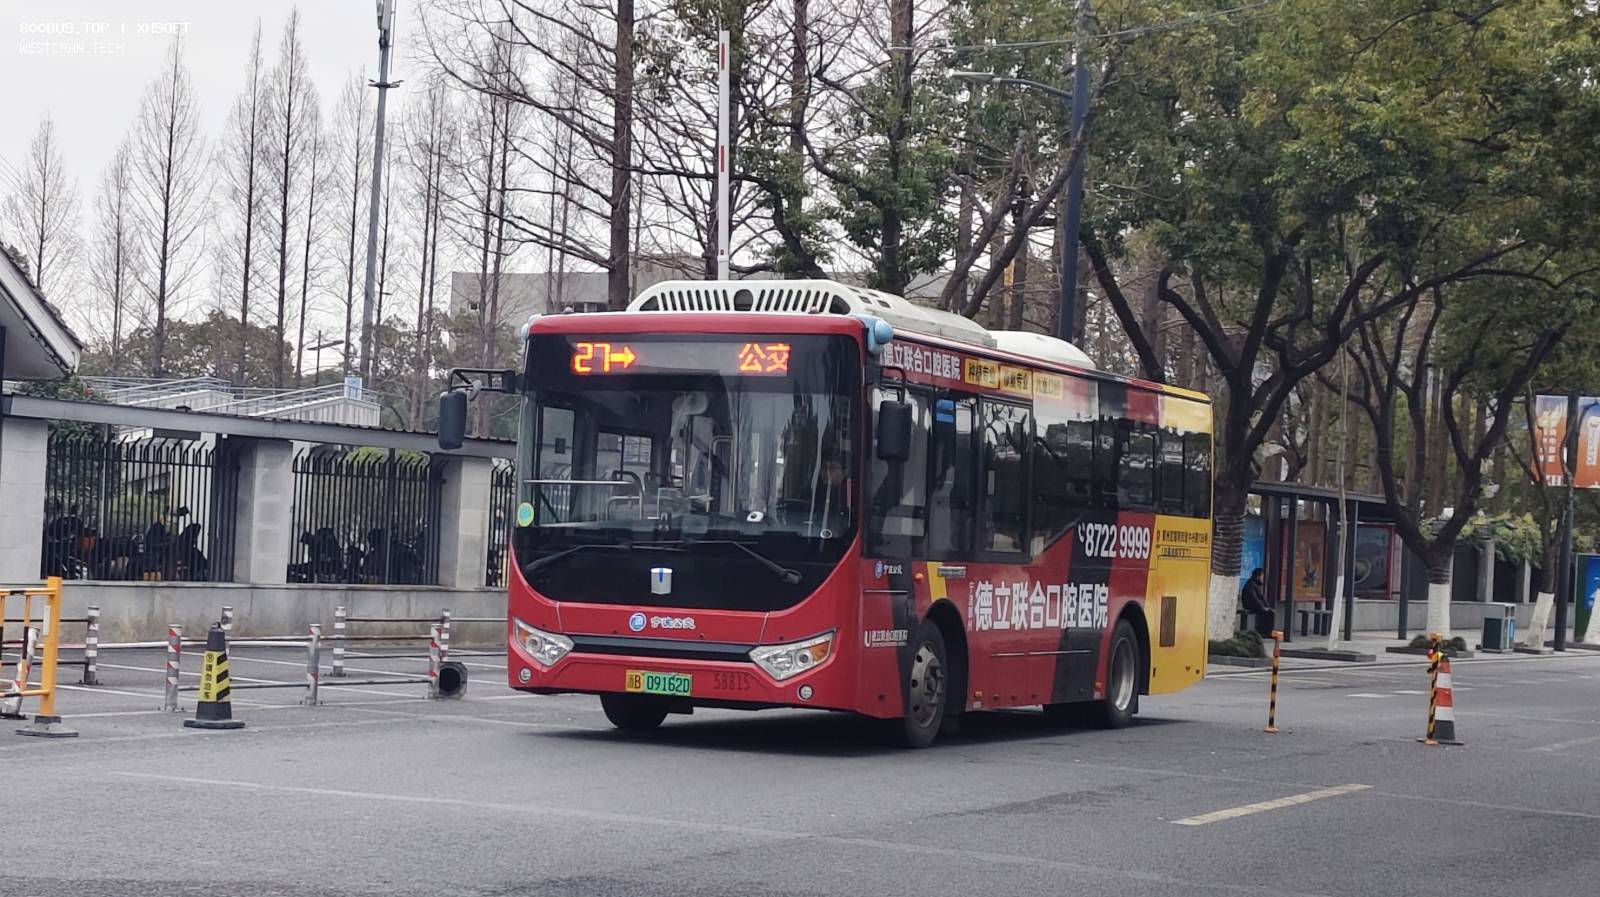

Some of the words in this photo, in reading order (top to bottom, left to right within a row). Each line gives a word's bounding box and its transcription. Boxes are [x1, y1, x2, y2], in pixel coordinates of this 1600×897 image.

[573, 342, 611, 373] 27
[738, 342, 791, 373] 公交
[1084, 523, 1117, 558] 8722
[1119, 526, 1151, 560] 9999
[974, 580, 1109, 632] 德立联合口腔医院
[646, 675, 691, 693] 09162D
[713, 672, 752, 691] 58815
